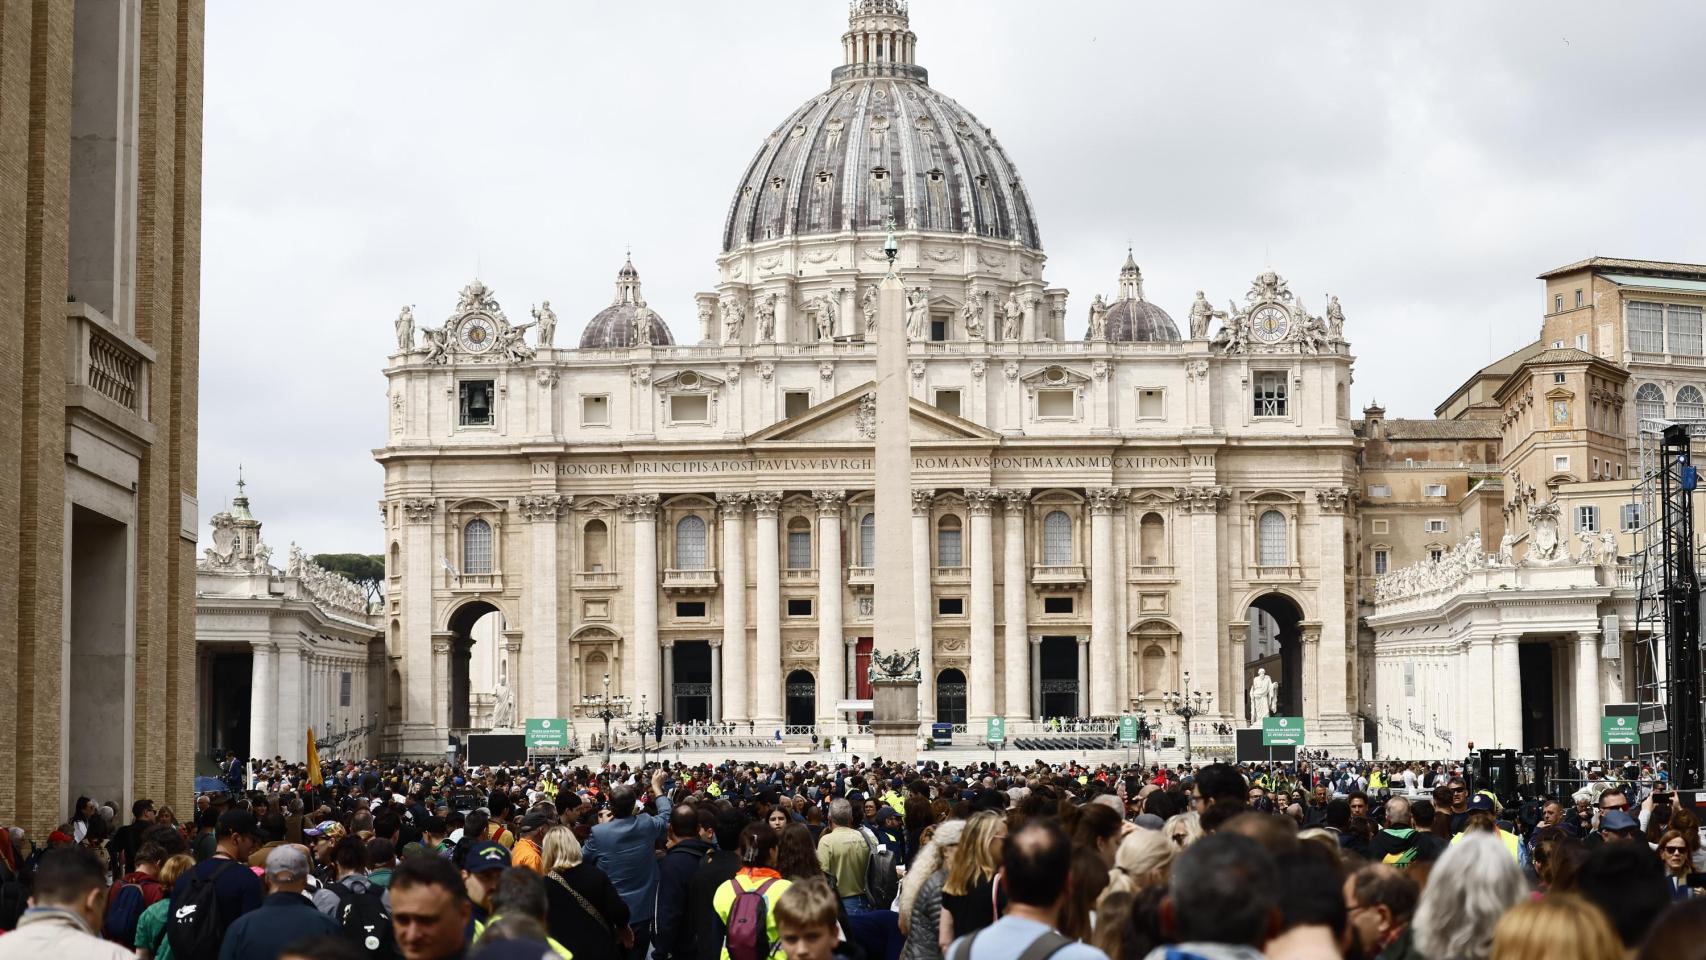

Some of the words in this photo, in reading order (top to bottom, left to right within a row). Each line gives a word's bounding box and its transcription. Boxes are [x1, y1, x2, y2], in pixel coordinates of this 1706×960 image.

[533, 463, 550, 475] IN
[557, 463, 630, 475] HONOREM
[915, 457, 990, 469] ROMANVS
[1193, 455, 1213, 467] VII
